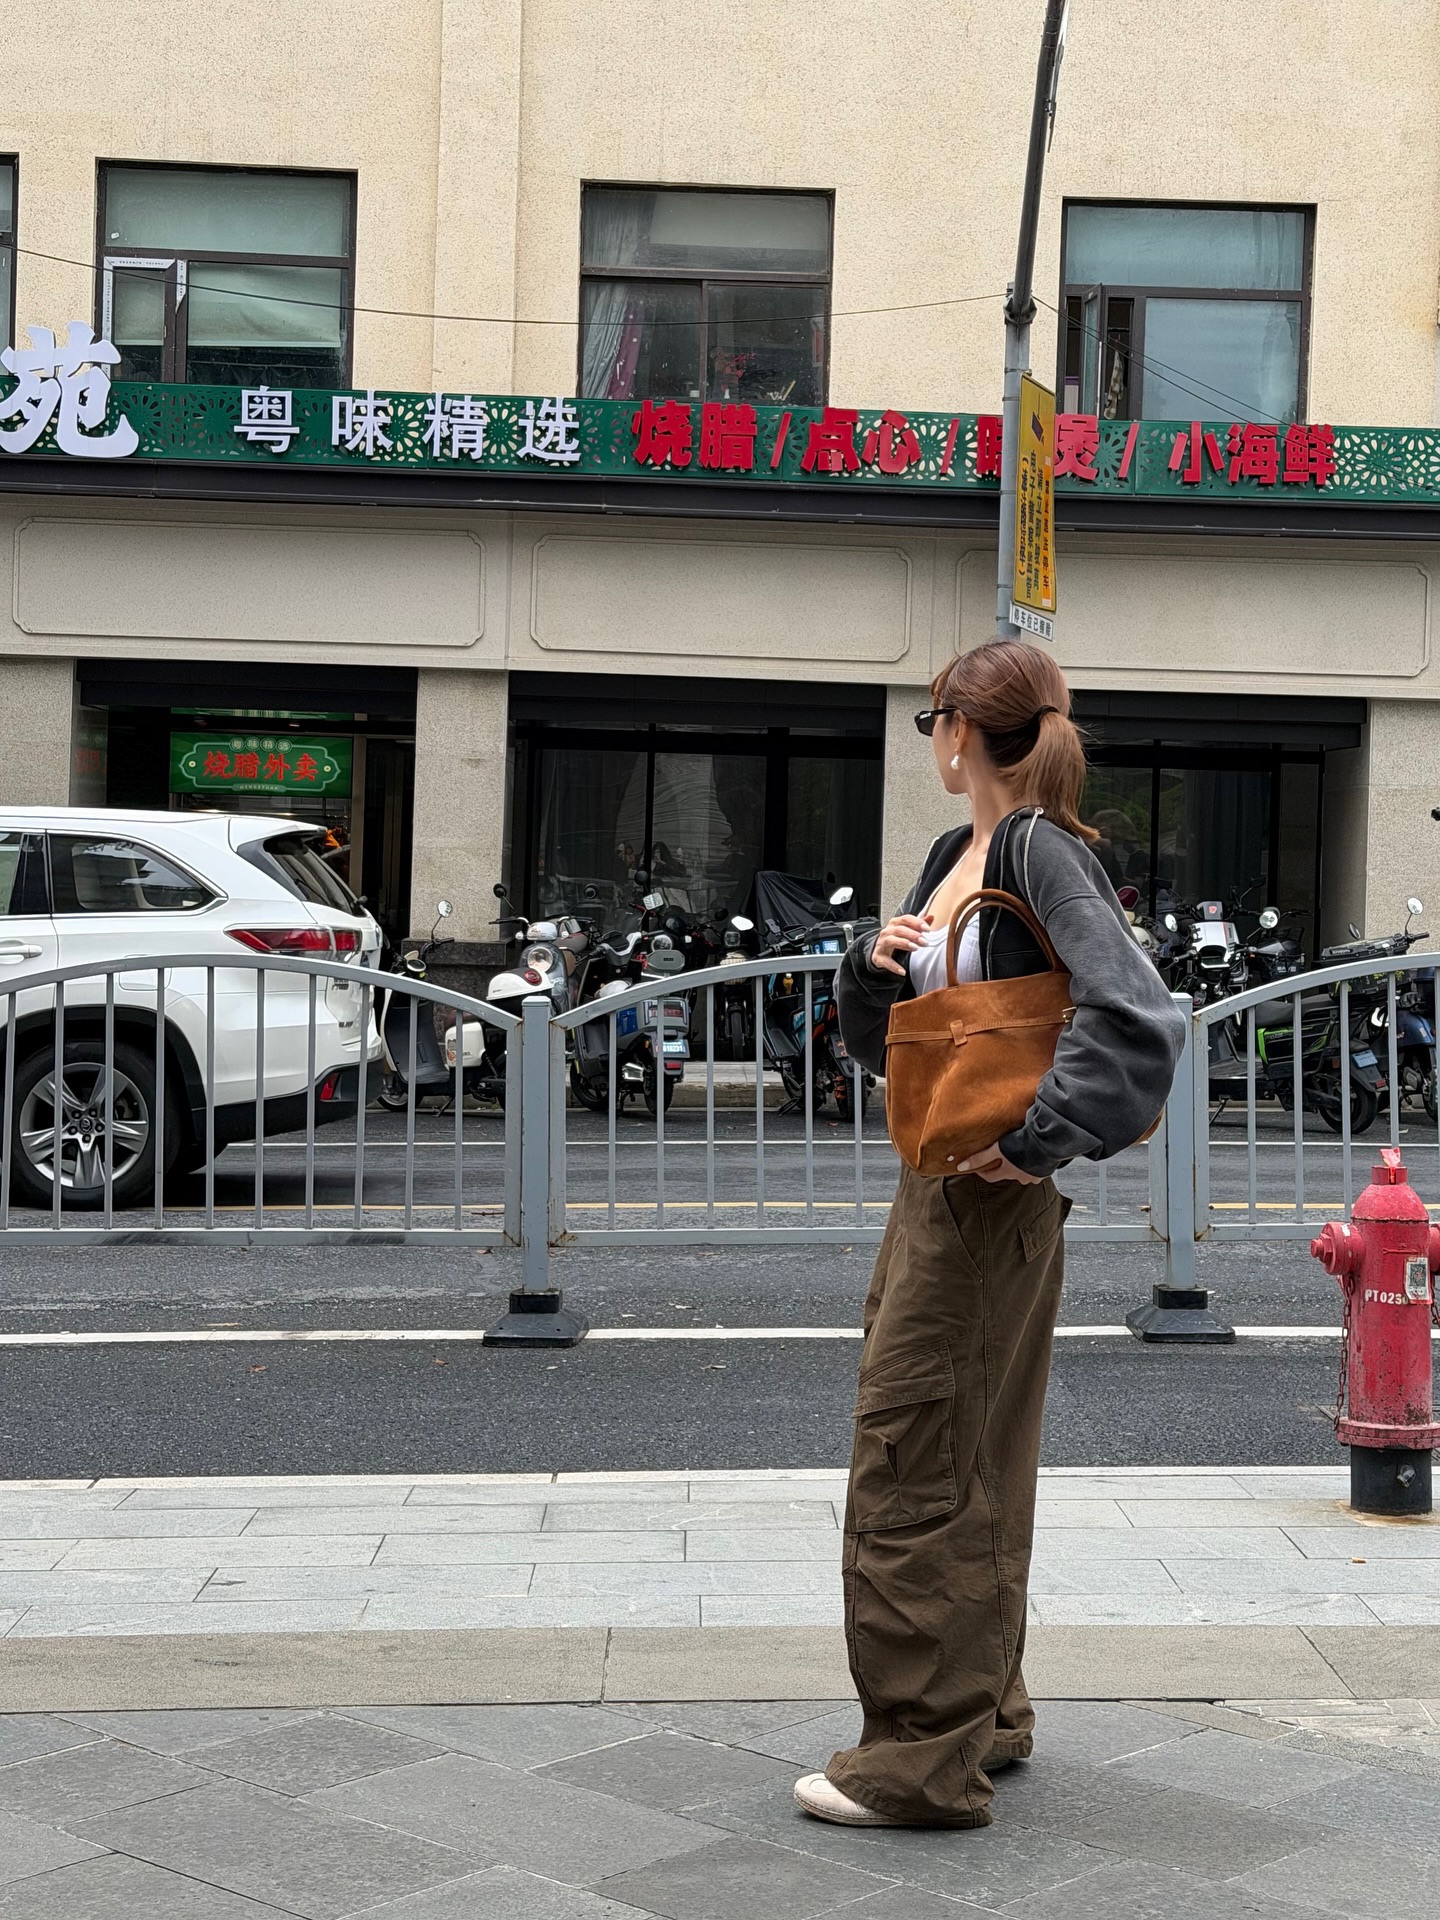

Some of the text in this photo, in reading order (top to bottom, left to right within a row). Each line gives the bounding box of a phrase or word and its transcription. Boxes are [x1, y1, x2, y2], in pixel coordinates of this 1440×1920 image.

[0, 320, 139, 458] 苑
[233, 385, 582, 462] 粤味精选
[203, 751, 319, 782] 烧腊外卖
